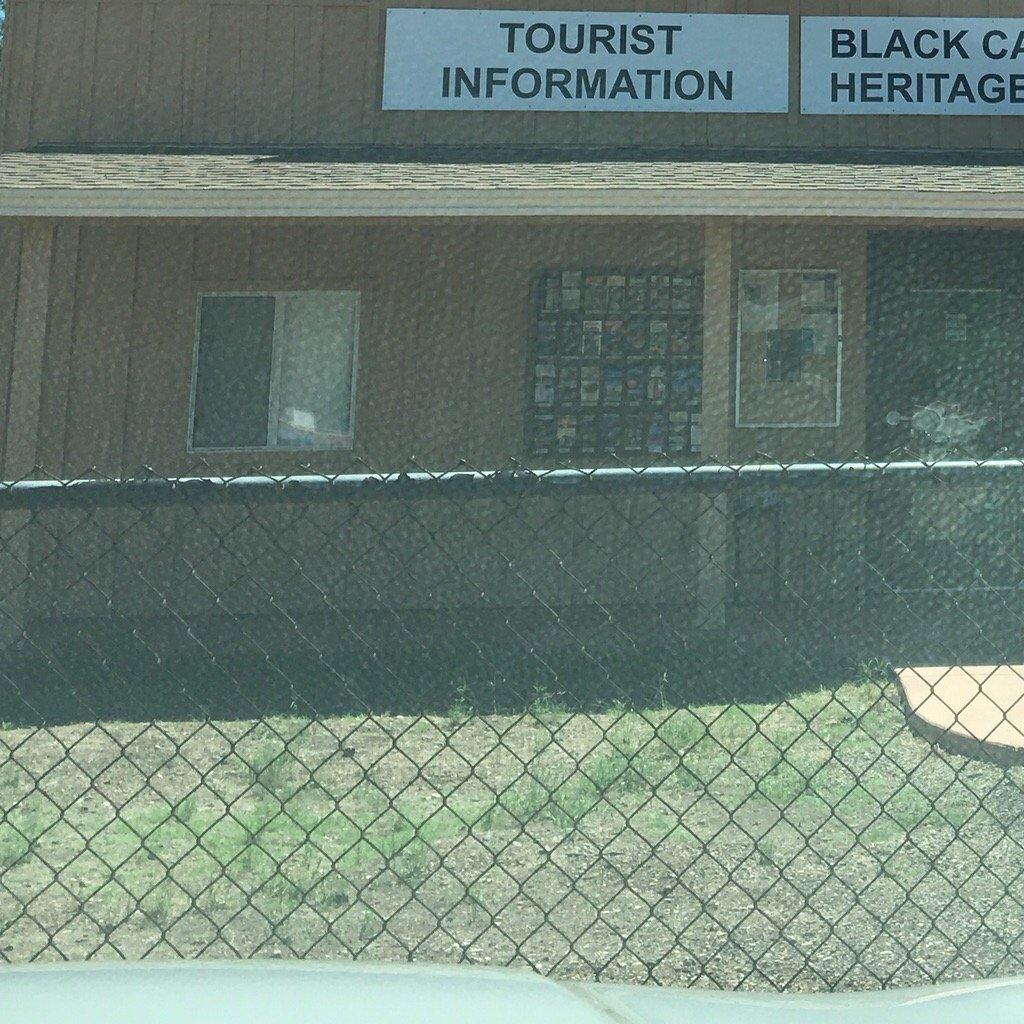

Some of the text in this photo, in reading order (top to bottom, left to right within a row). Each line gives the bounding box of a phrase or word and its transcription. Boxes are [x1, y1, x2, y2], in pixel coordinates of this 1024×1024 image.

[499, 22, 683, 56] TOURIST
[830, 28, 969, 60] BLACK
[441, 66, 734, 101] INFORMATION
